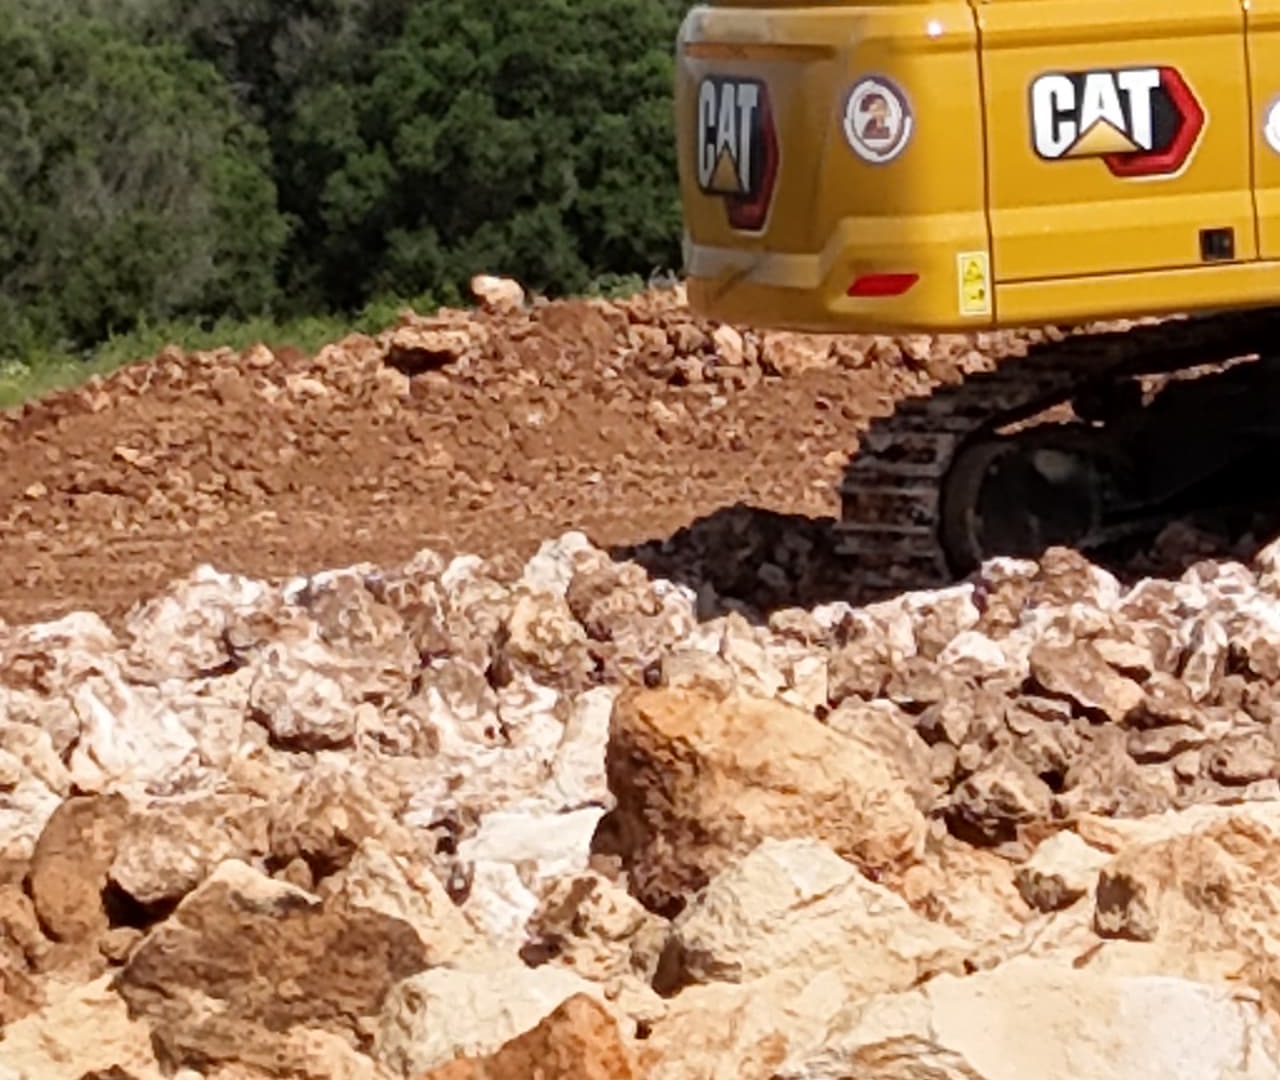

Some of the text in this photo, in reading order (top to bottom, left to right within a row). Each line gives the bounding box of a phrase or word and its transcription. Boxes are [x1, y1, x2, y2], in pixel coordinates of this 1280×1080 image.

[699, 80, 758, 192] CAT
[860, 92, 890, 139] 2
[1033, 69, 1160, 158] CAT
